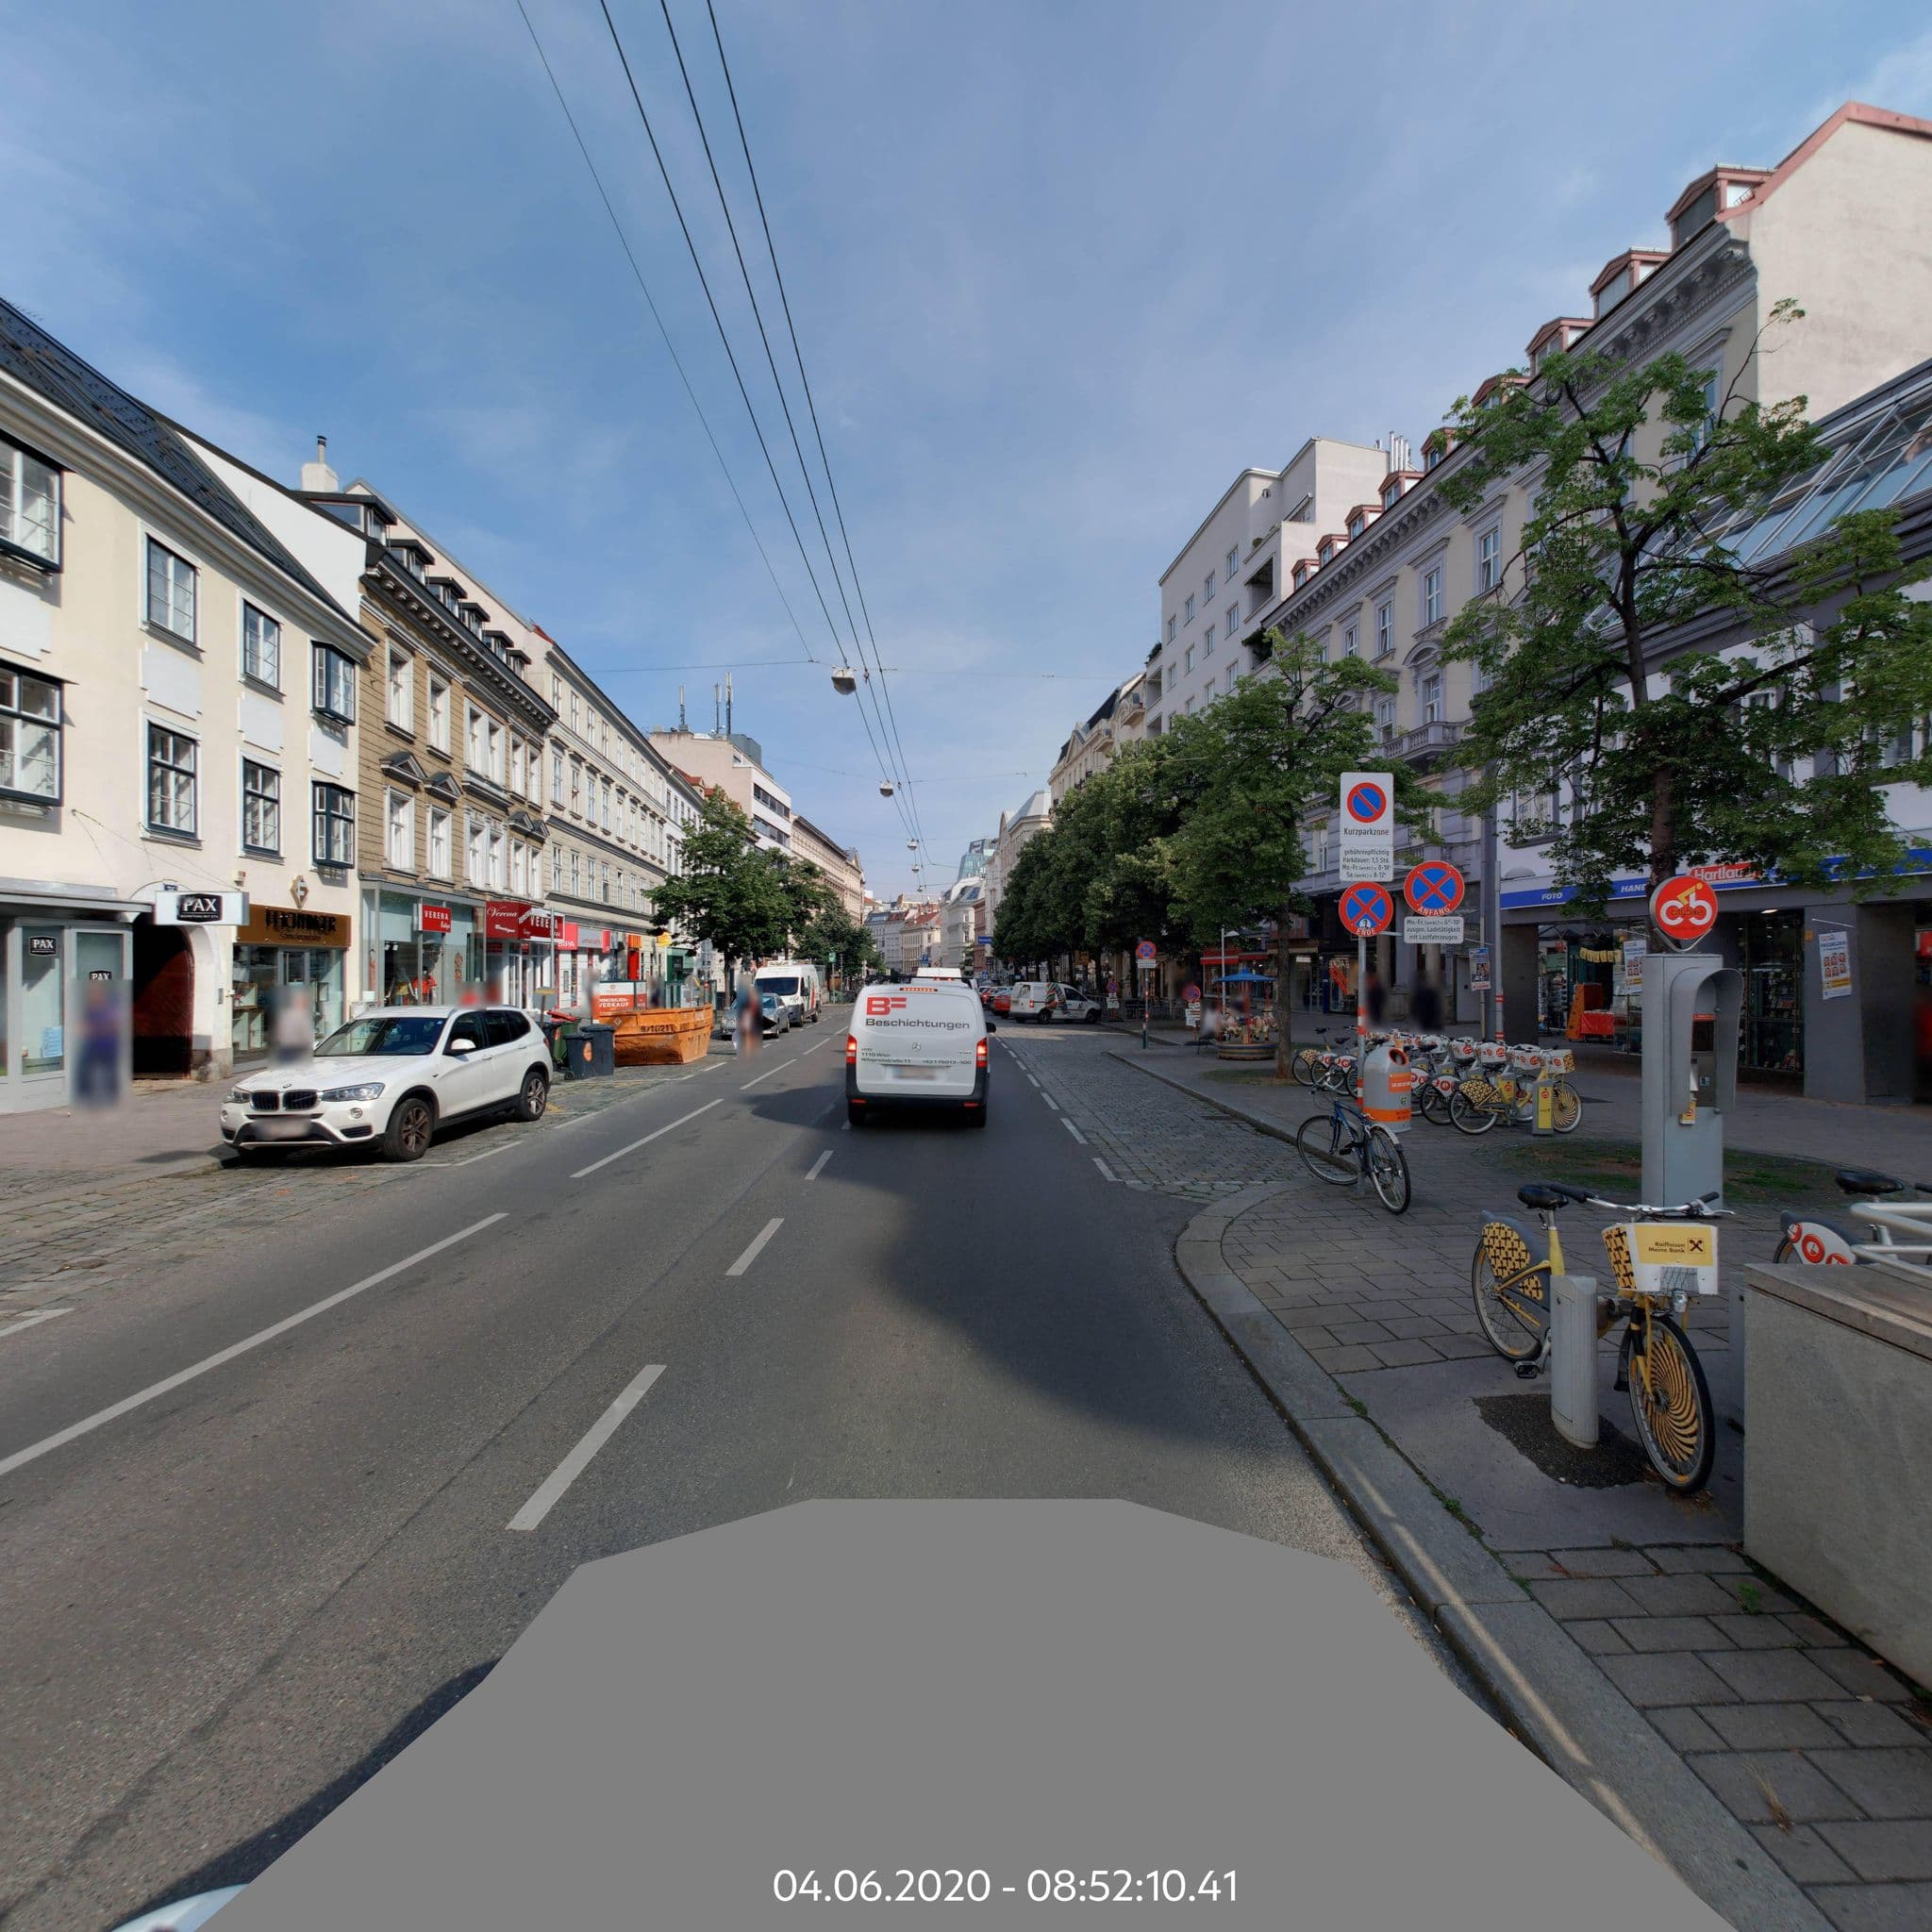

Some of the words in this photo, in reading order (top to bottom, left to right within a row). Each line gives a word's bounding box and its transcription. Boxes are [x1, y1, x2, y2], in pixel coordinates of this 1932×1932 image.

[1343, 827, 1389, 836] Kurzparkzone
[1694, 865, 1757, 881] Hartlau
[1541, 892, 1563, 901] FOTO
[183, 898, 217, 912] PAX
[425, 910, 449, 921] VERENA
[487, 907, 518, 917] Verena
[1417, 906, 1450, 915] ANFANG
[530, 916, 558, 929] VEREA
[32, 939, 54, 949] PAX
[91, 973, 110, 981] PAX
[866, 996, 908, 1016] BF
[865, 1018, 971, 1031] Beschichtungen
